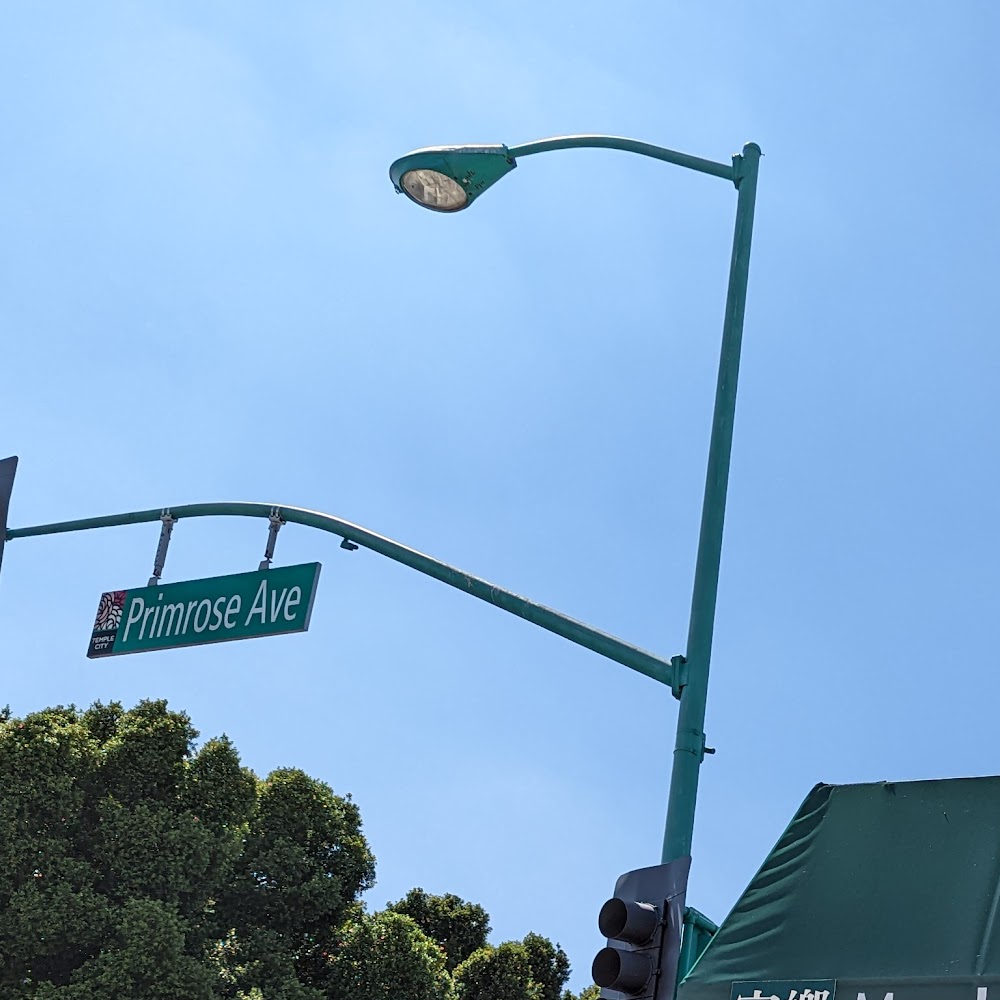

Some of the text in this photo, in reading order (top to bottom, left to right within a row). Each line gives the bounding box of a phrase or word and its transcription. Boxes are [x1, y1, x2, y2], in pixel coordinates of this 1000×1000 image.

[122, 579, 302, 642] Primrose Ave
[92, 636, 115, 644] TEMPLE
